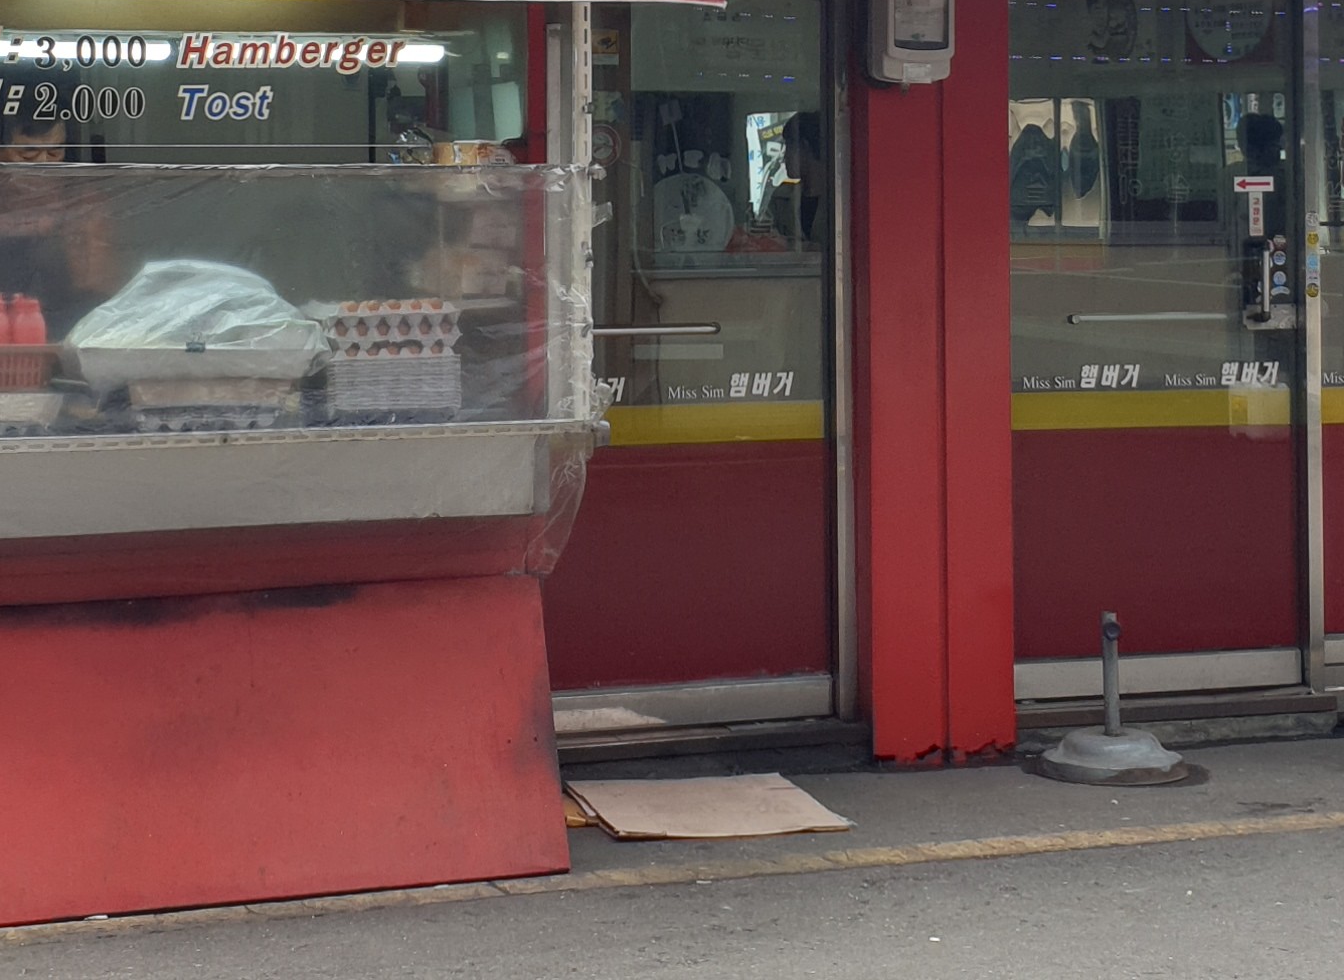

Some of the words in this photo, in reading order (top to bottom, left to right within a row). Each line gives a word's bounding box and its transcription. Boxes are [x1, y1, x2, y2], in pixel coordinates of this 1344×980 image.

[34, 33, 147, 72] 3,000
[176, 32, 405, 75] Hamberger
[33, 81, 146, 123] 2.000
[178, 84, 274, 120] Tost
[668, 386, 697, 400] Miss
[701, 384, 724, 399] Sim
[729, 371, 794, 398] 햄버거
[1022, 375, 1051, 390] Miss
[1054, 375, 1076, 389] Sim
[1080, 364, 1140, 389] 햄버거
[1164, 373, 1192, 387] Miss
[1195, 372, 1216, 386] Sim
[1220, 361, 1279, 386] 햄버거
